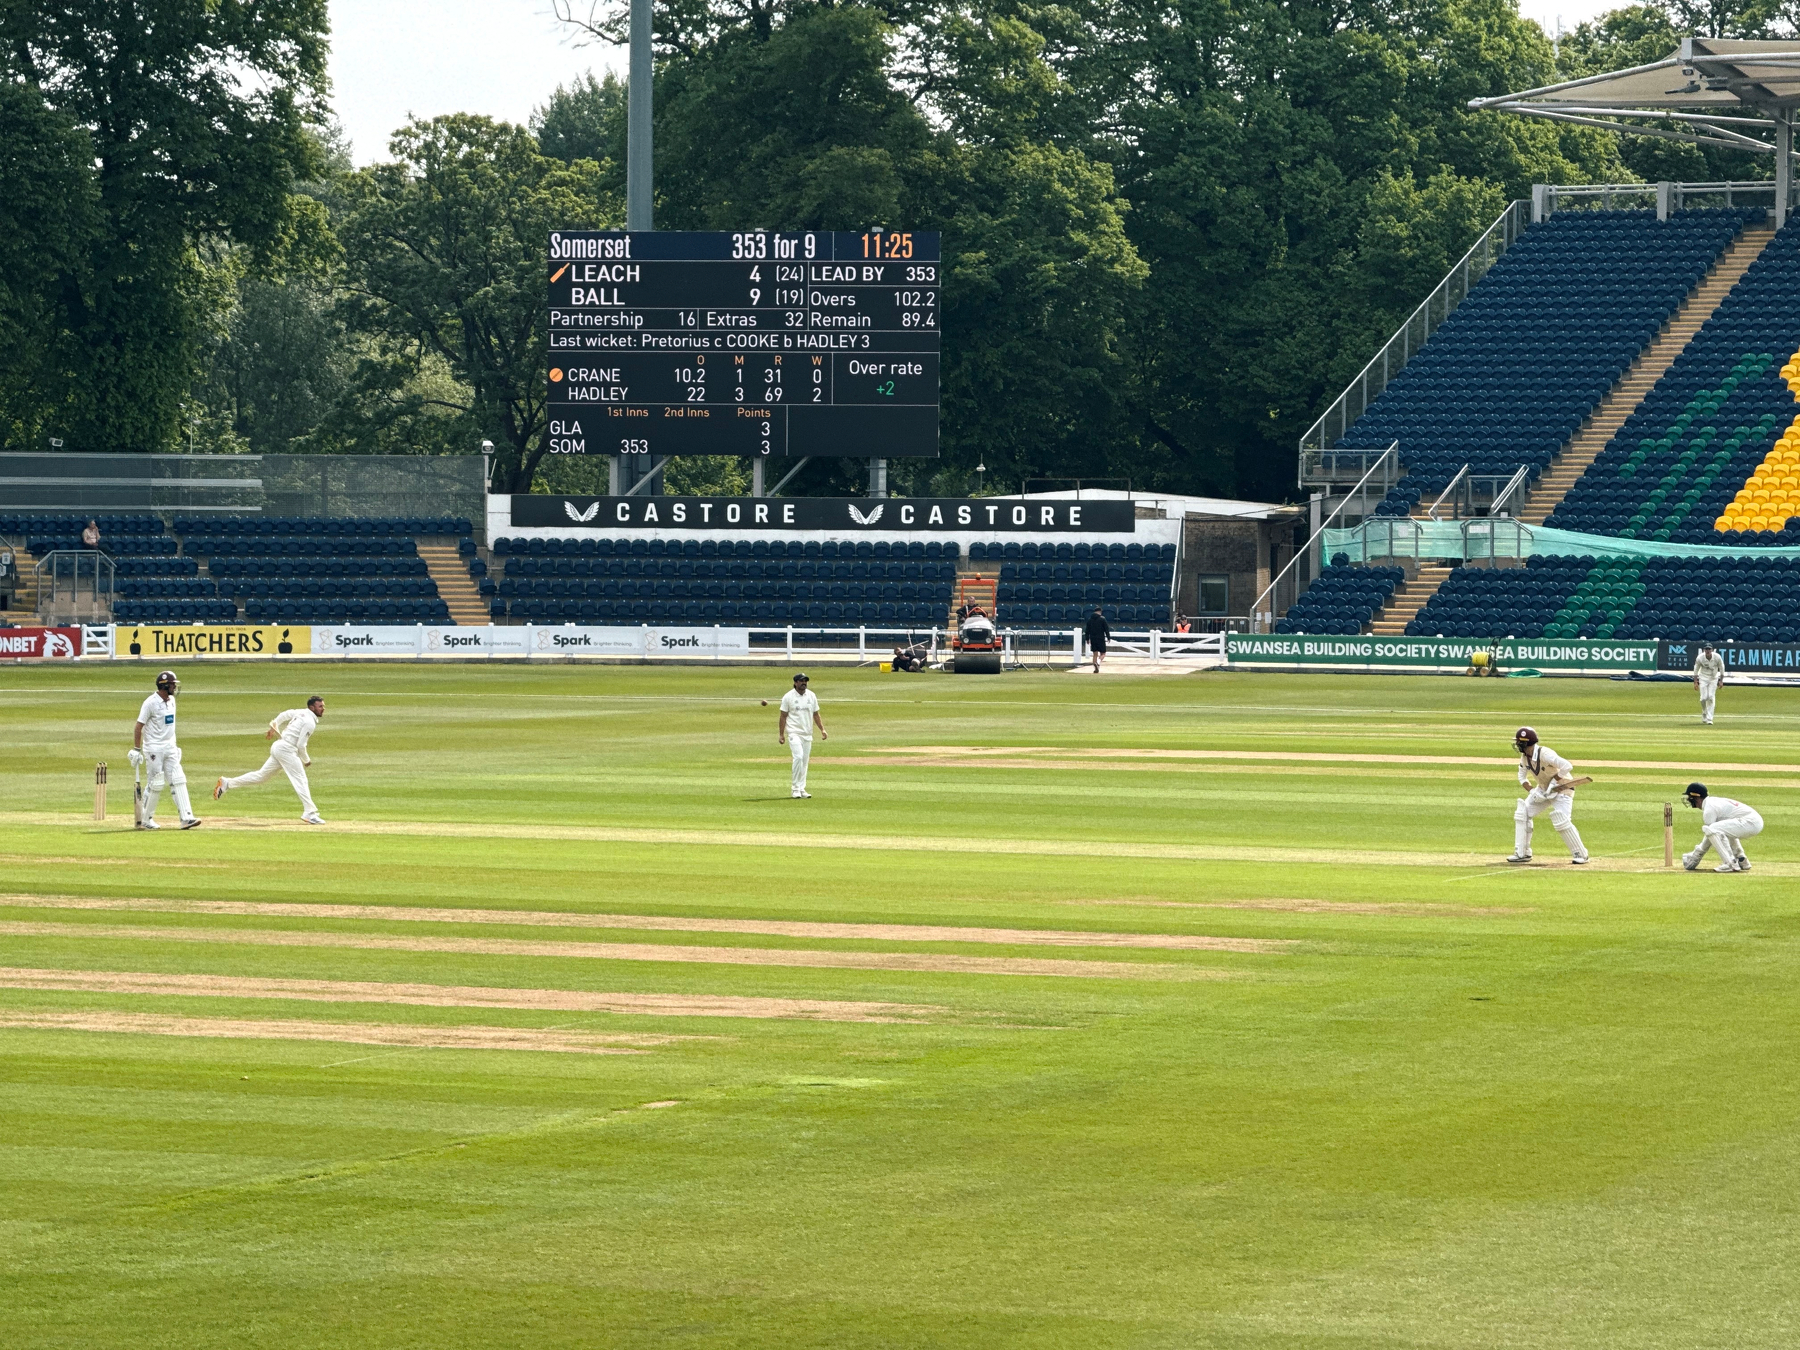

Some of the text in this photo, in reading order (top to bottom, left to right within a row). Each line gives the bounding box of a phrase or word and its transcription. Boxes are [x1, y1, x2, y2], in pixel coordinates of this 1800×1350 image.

[550, 233, 816, 258] Somerset 353 for 9
[861, 234, 913, 258] 11:25
[571, 264, 804, 282] LEACH 4 (24)
[811, 266, 935, 281] LEAD BY 353
[571, 288, 804, 305] BALL 9 (19)
[811, 292, 935, 306] Overs 102.2
[551, 311, 696, 329] Partnership 16
[707, 312, 804, 326] Extras 32
[811, 313, 935, 326] Remain 89.4
[550, 333, 870, 348] Last wicket: Pretorius c COOKE b HADLEY 3
[735, 355, 744, 365] M
[774, 355, 782, 365] R
[811, 355, 822, 365] W
[849, 360, 923, 375] Over rate
[568, 368, 822, 383] CRANE 10.2 1 31 0
[568, 387, 822, 402] HADLEY 22 3 69 2
[876, 381, 895, 395] +2
[607, 406, 771, 418] 1st Inns 2nd Inns Points
[550, 421, 770, 435] GLA 3
[549, 439, 770, 454] SOM 353 3
[616, 502, 796, 523] CASTORE
[900, 505, 1083, 526] CASTORE
[0, 636, 38, 652] NBET
[152, 630, 263, 652] THATCHERS
[336, 634, 373, 648] Spark
[444, 634, 481, 648] Spark
[553, 634, 591, 648] Spark
[661, 635, 699, 649] Spark
[1228, 640, 1438, 657] SWANSEA BUILDING SOCIETY
[1518, 646, 1589, 660] BUILDING
[1591, 647, 1656, 662] SOCIETY
[1668, 644, 1688, 654] NX
